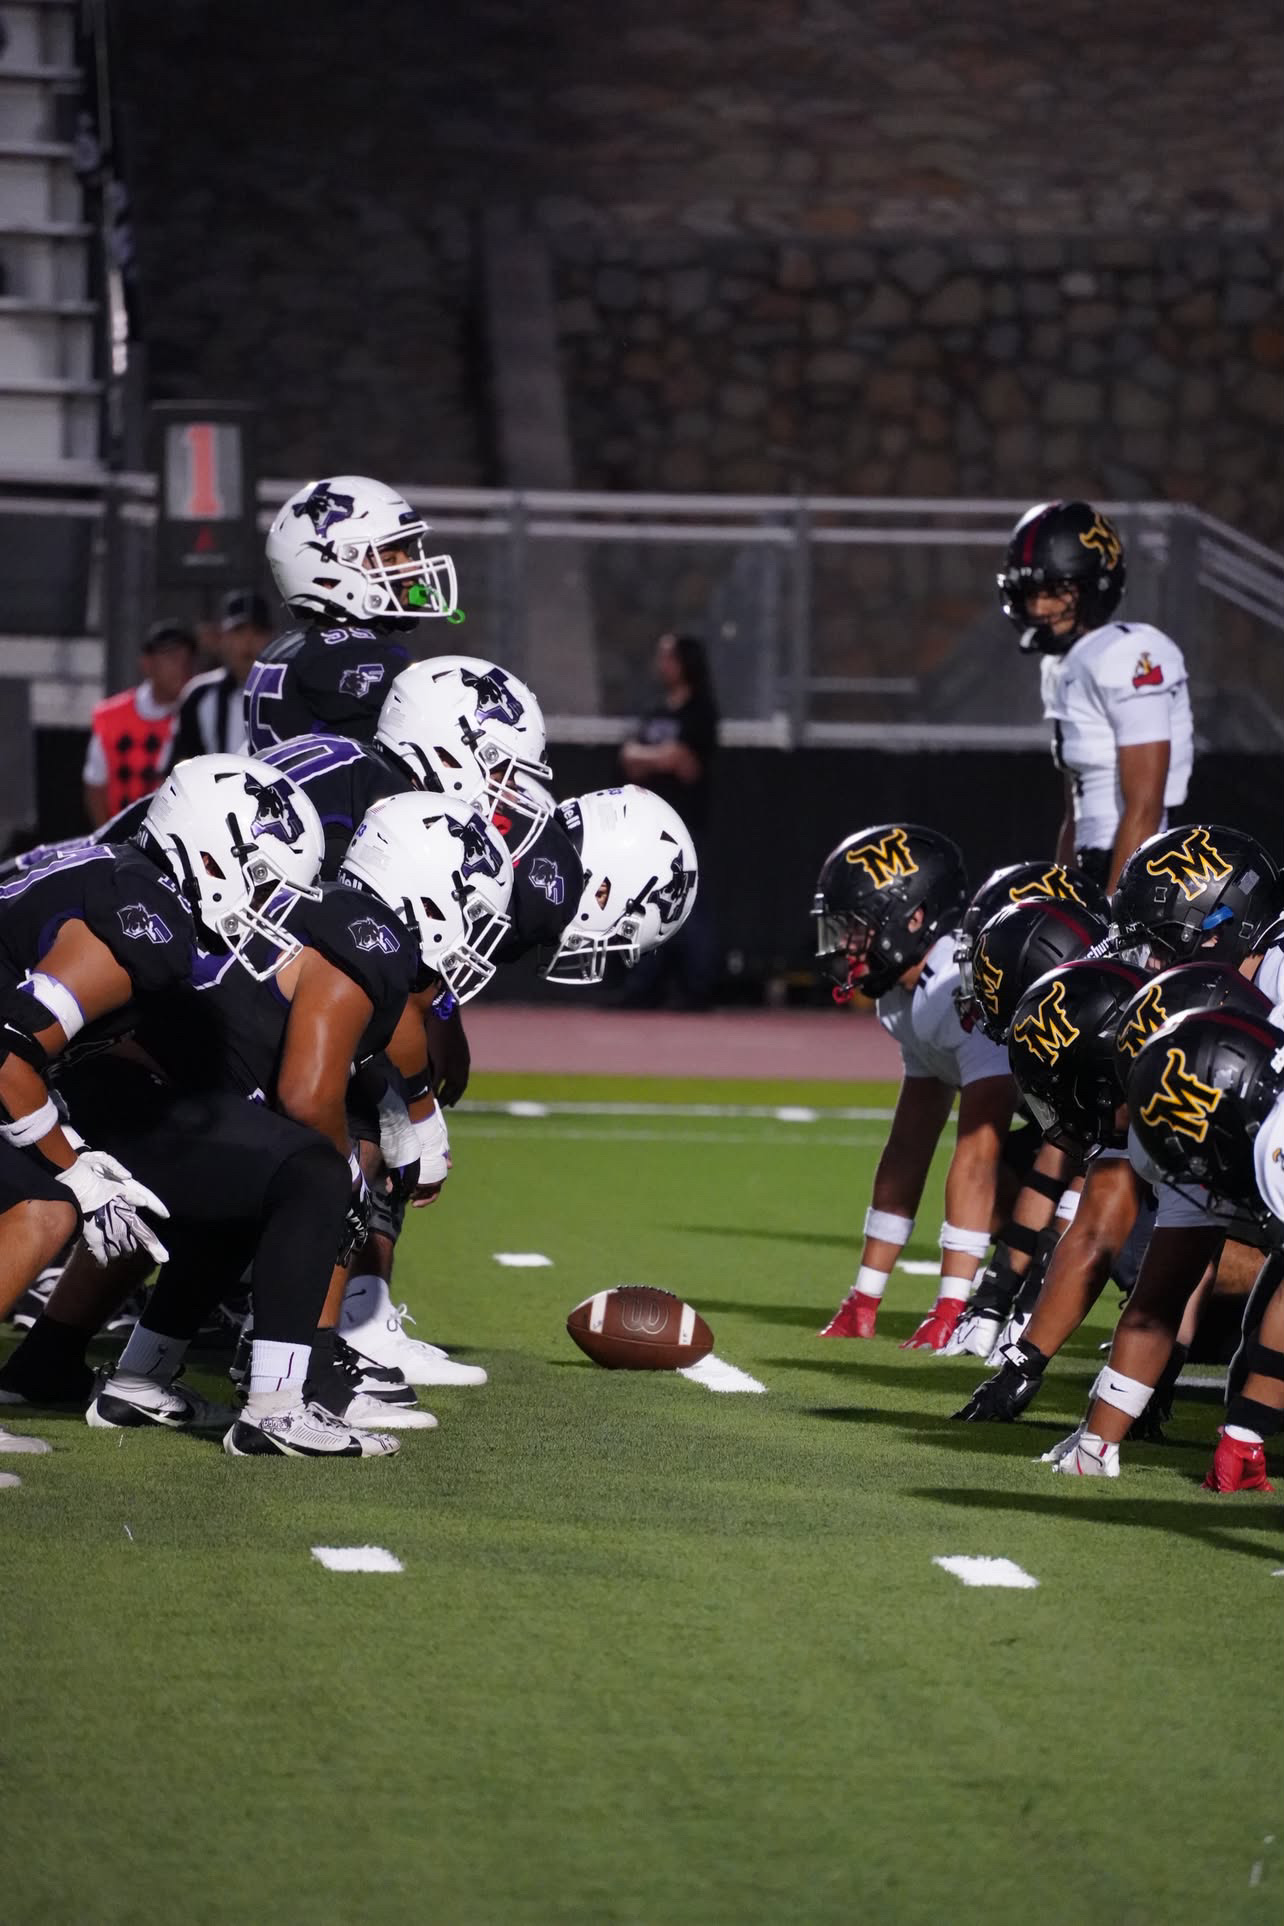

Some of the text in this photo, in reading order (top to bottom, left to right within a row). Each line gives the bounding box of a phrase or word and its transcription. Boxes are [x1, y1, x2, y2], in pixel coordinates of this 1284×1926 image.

[186, 422, 219, 516] 1
[846, 828, 919, 890] M
[1146, 829, 1233, 901] M
[1014, 981, 1080, 1067] M
[1117, 984, 1169, 1058] M
[1140, 1048, 1223, 1143] M
